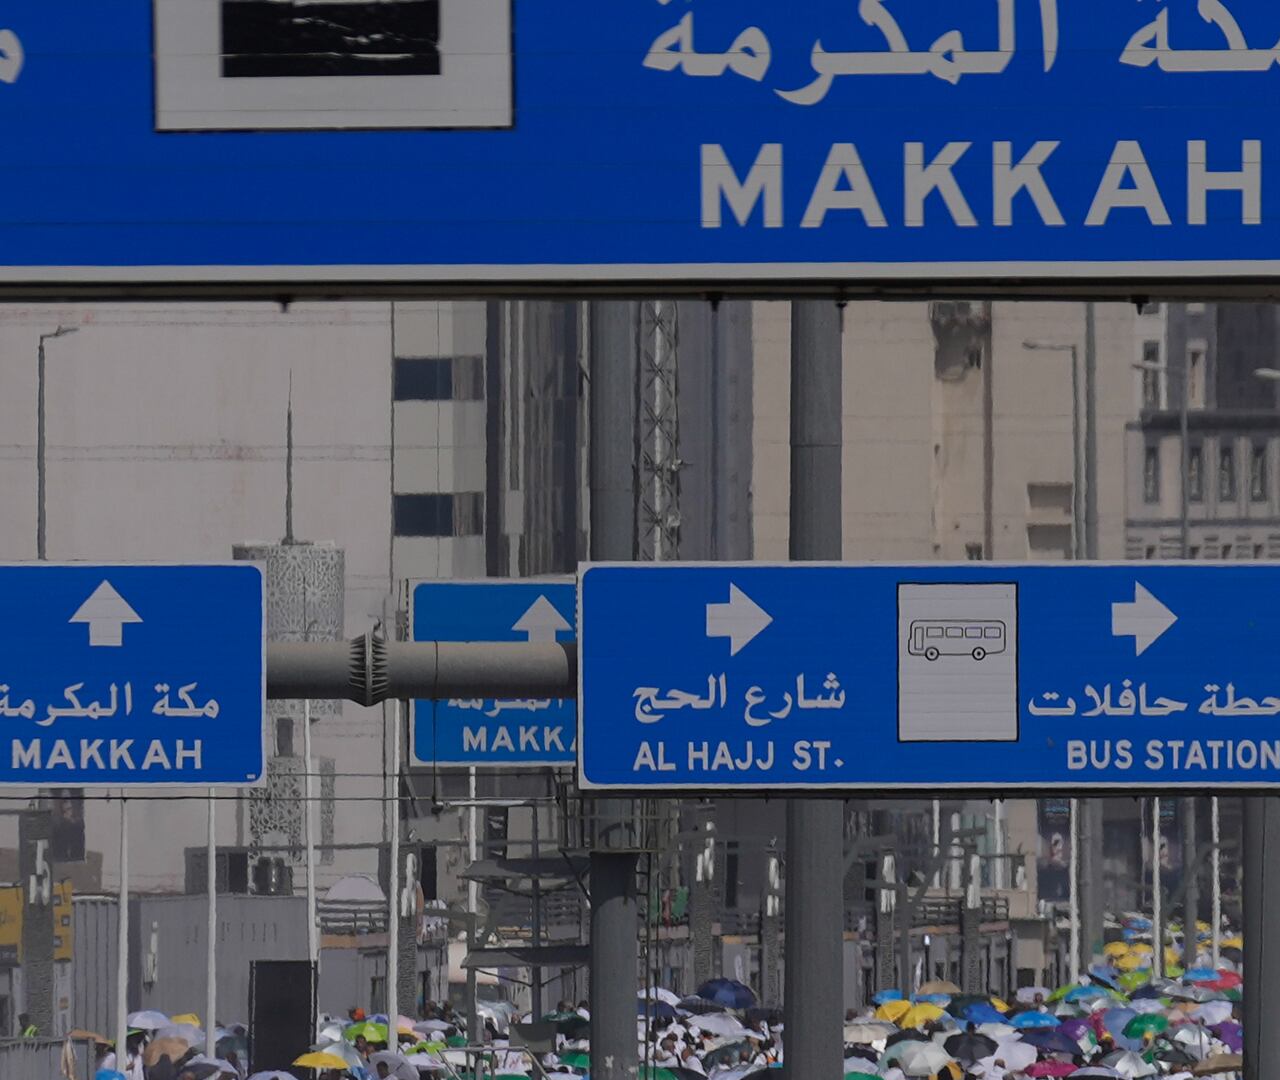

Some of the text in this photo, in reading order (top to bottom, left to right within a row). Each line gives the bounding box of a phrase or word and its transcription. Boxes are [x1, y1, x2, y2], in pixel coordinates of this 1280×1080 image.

[700, 140, 1262, 228] MAKKAH
[152, 682, 220, 719] مكة
[632, 672, 846, 726] شارع الحج
[1028, 679, 1188, 717] حافلات
[11, 738, 202, 770] MAKKAH
[462, 725, 577, 752] MAKK
[633, 740, 844, 771] AL HAJJ ST.
[1067, 739, 1133, 770] BUS
